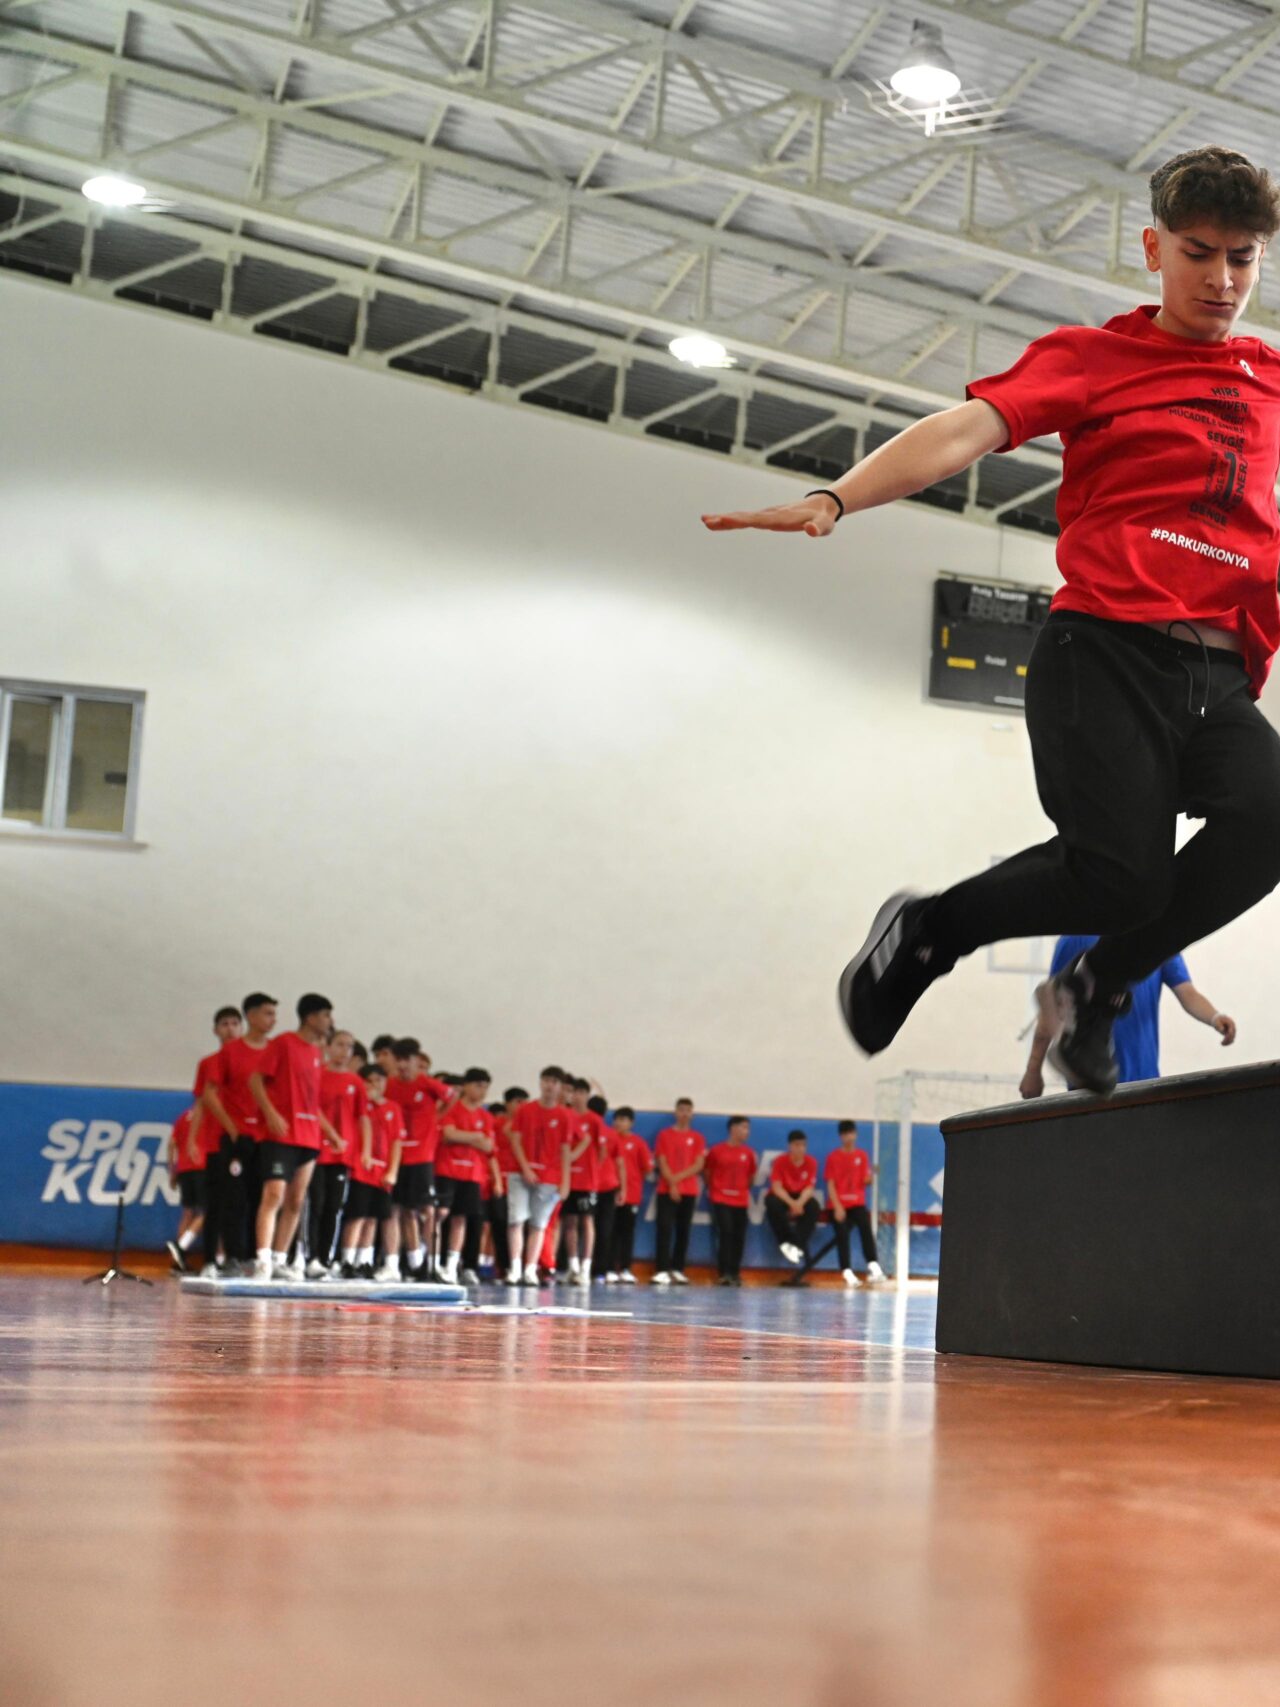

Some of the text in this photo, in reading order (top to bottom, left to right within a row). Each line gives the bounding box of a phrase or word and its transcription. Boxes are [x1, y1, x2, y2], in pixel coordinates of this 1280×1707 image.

[1150, 528, 1249, 570] #PARKURKONYA
[40, 1118, 174, 1174] SPO
[40, 1152, 182, 1206] KON
